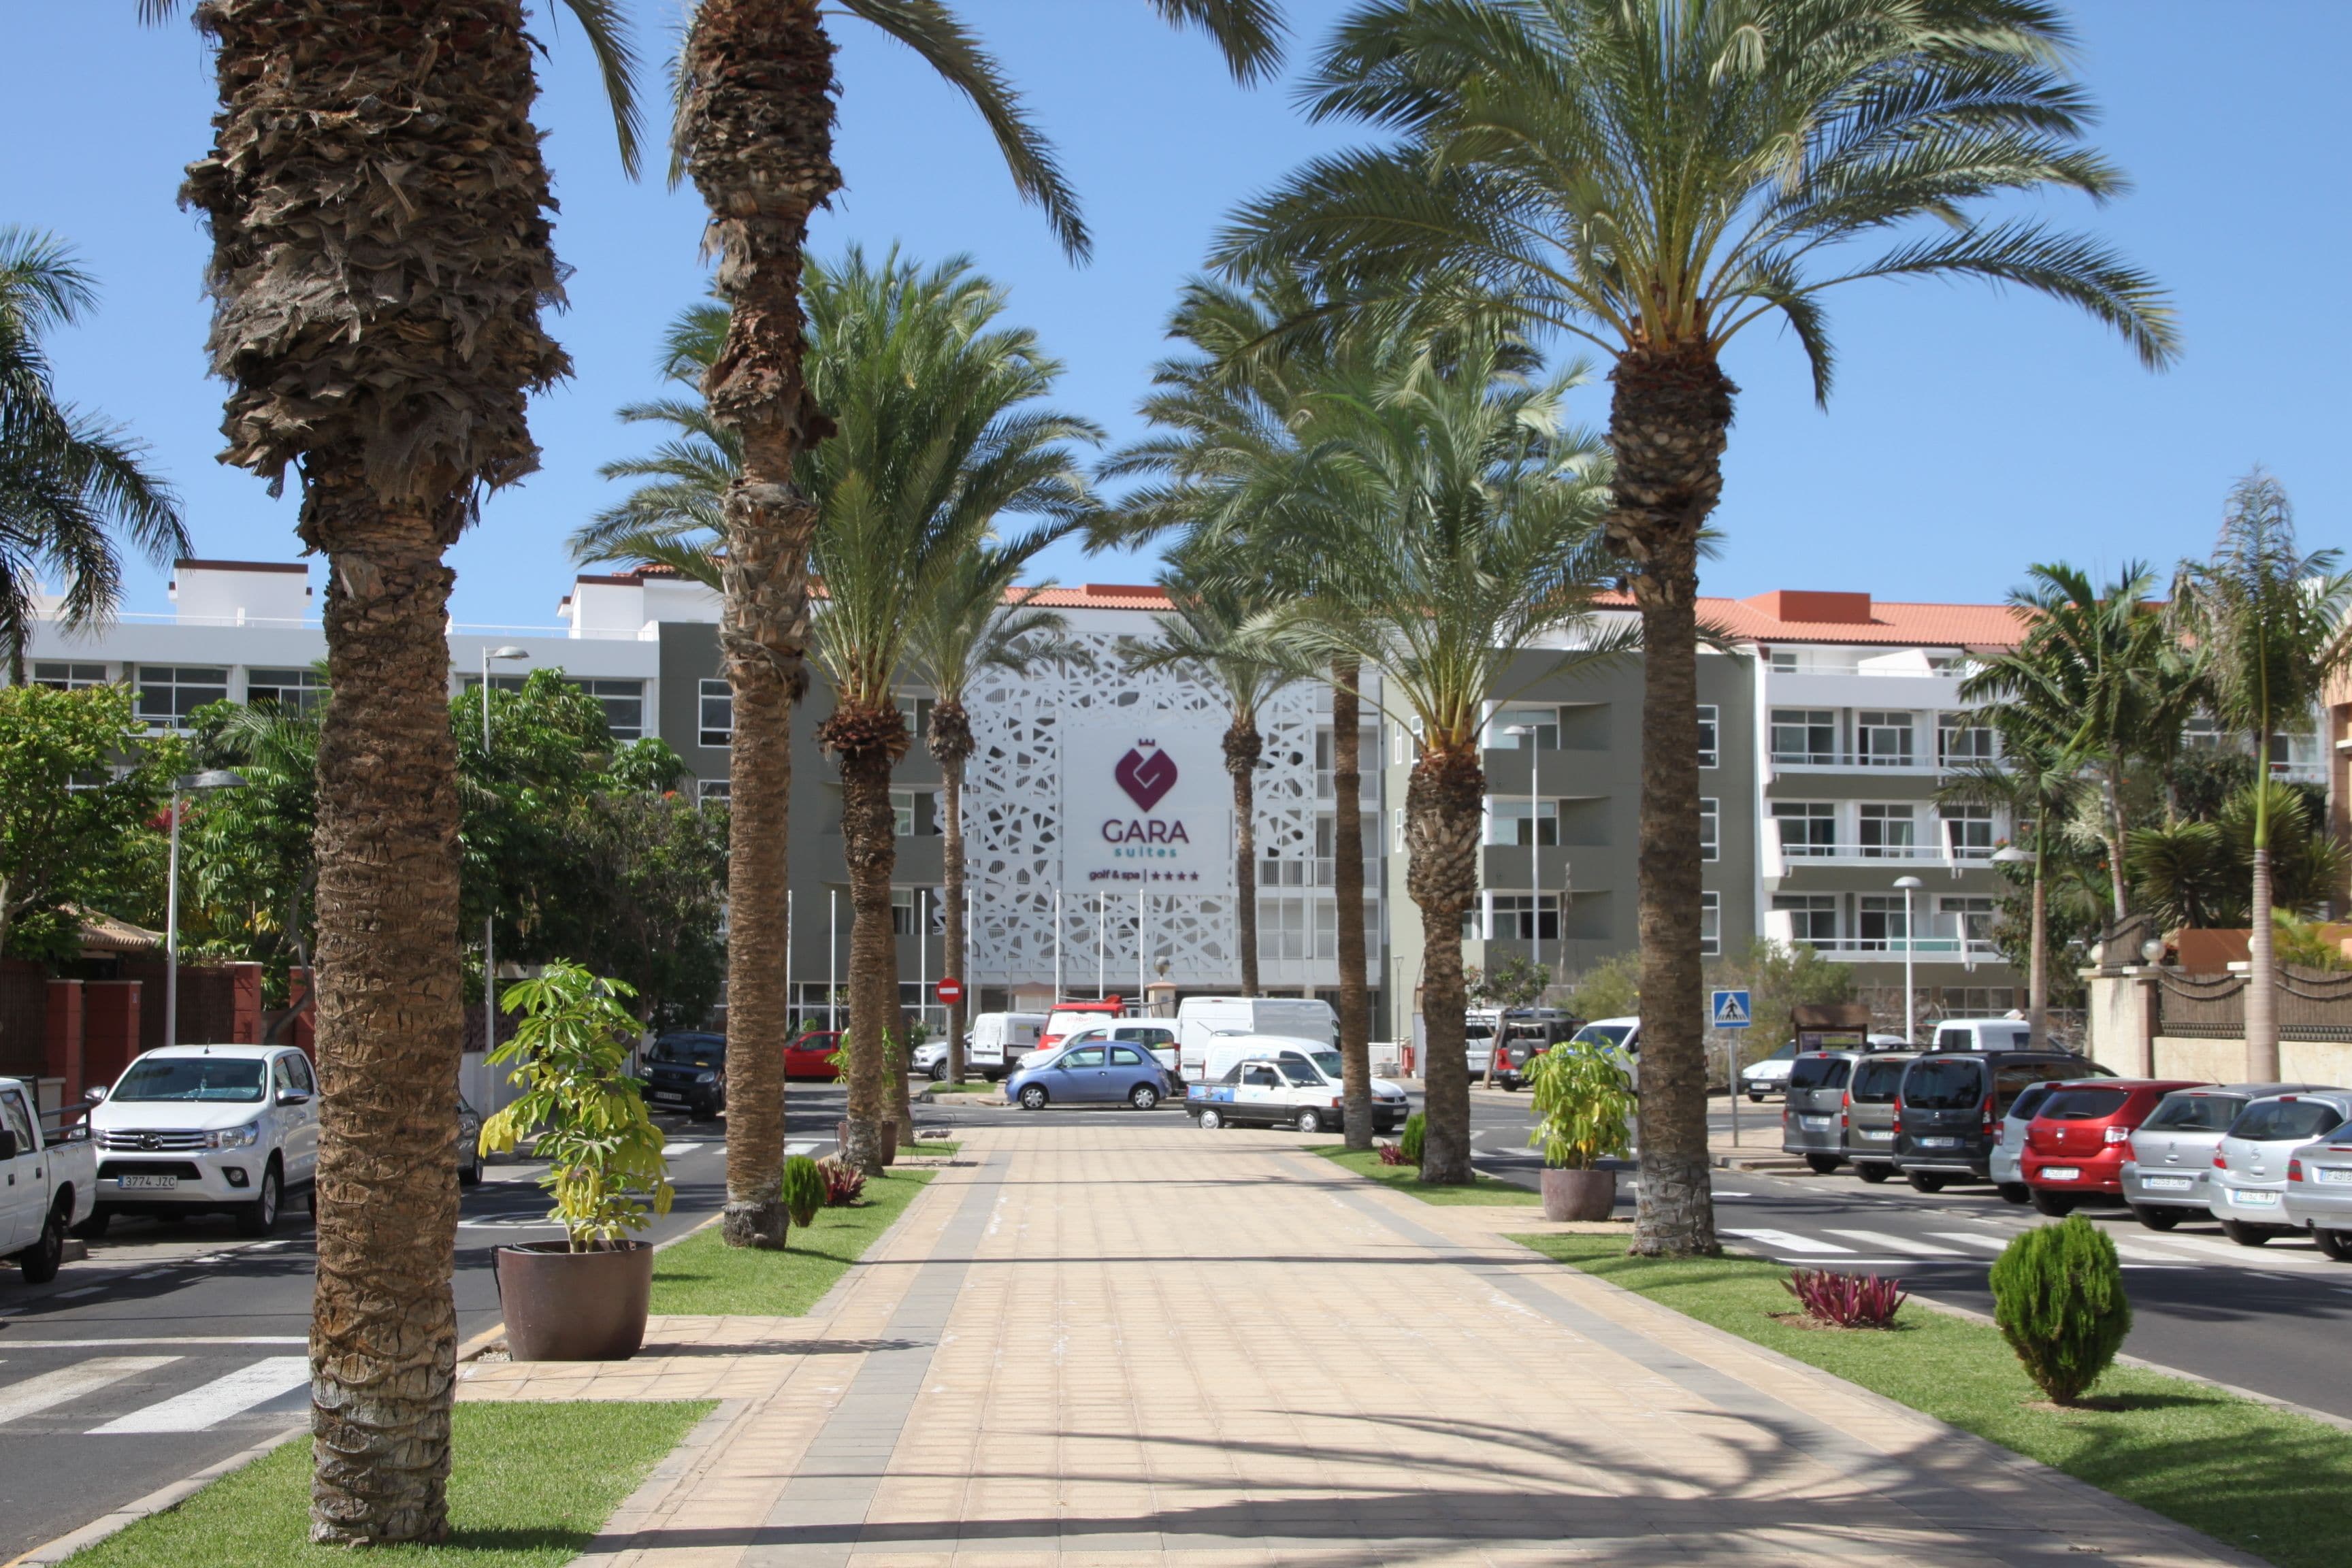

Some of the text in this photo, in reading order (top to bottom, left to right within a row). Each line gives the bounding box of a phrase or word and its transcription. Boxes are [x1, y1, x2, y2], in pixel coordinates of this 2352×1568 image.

[1102, 819, 1190, 844] GARA
[1114, 847, 1177, 858] suites
[1089, 870, 1140, 881] golf & spa
[126, 1177, 175, 1186] 3774 JZC
